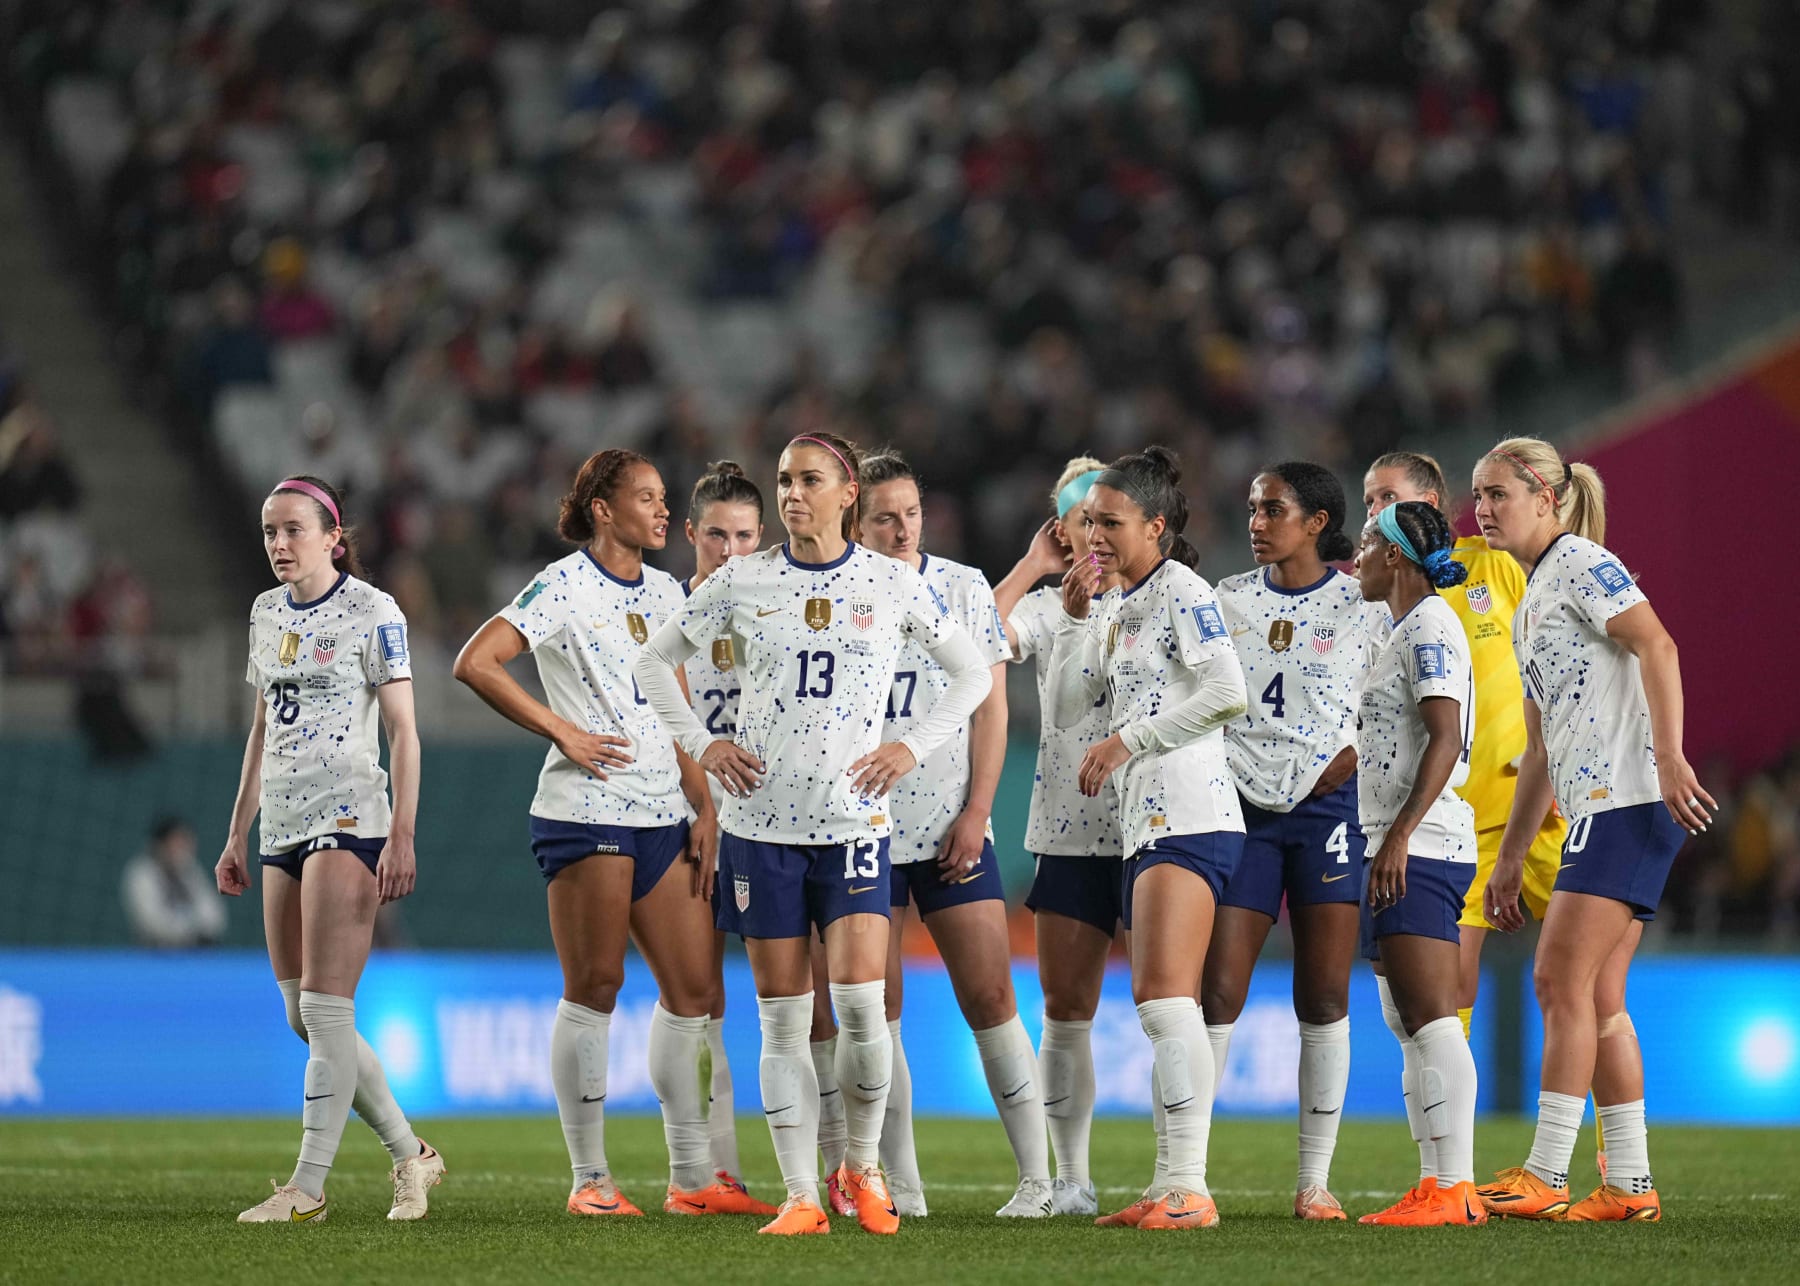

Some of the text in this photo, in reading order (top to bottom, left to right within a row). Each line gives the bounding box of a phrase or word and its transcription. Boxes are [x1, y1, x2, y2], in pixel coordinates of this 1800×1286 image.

[1468, 587, 1488, 600] USA
[852, 603, 873, 616] USA
[1127, 623, 1142, 636] USA
[1314, 628, 1334, 640] USA
[317, 638, 336, 651] USA
[795, 650, 835, 699] 13
[1261, 671, 1285, 719] 4
[1563, 814, 1593, 855] 0
[1325, 821, 1350, 864] 4
[843, 838, 880, 879] 13
[735, 882, 748, 895] USA
